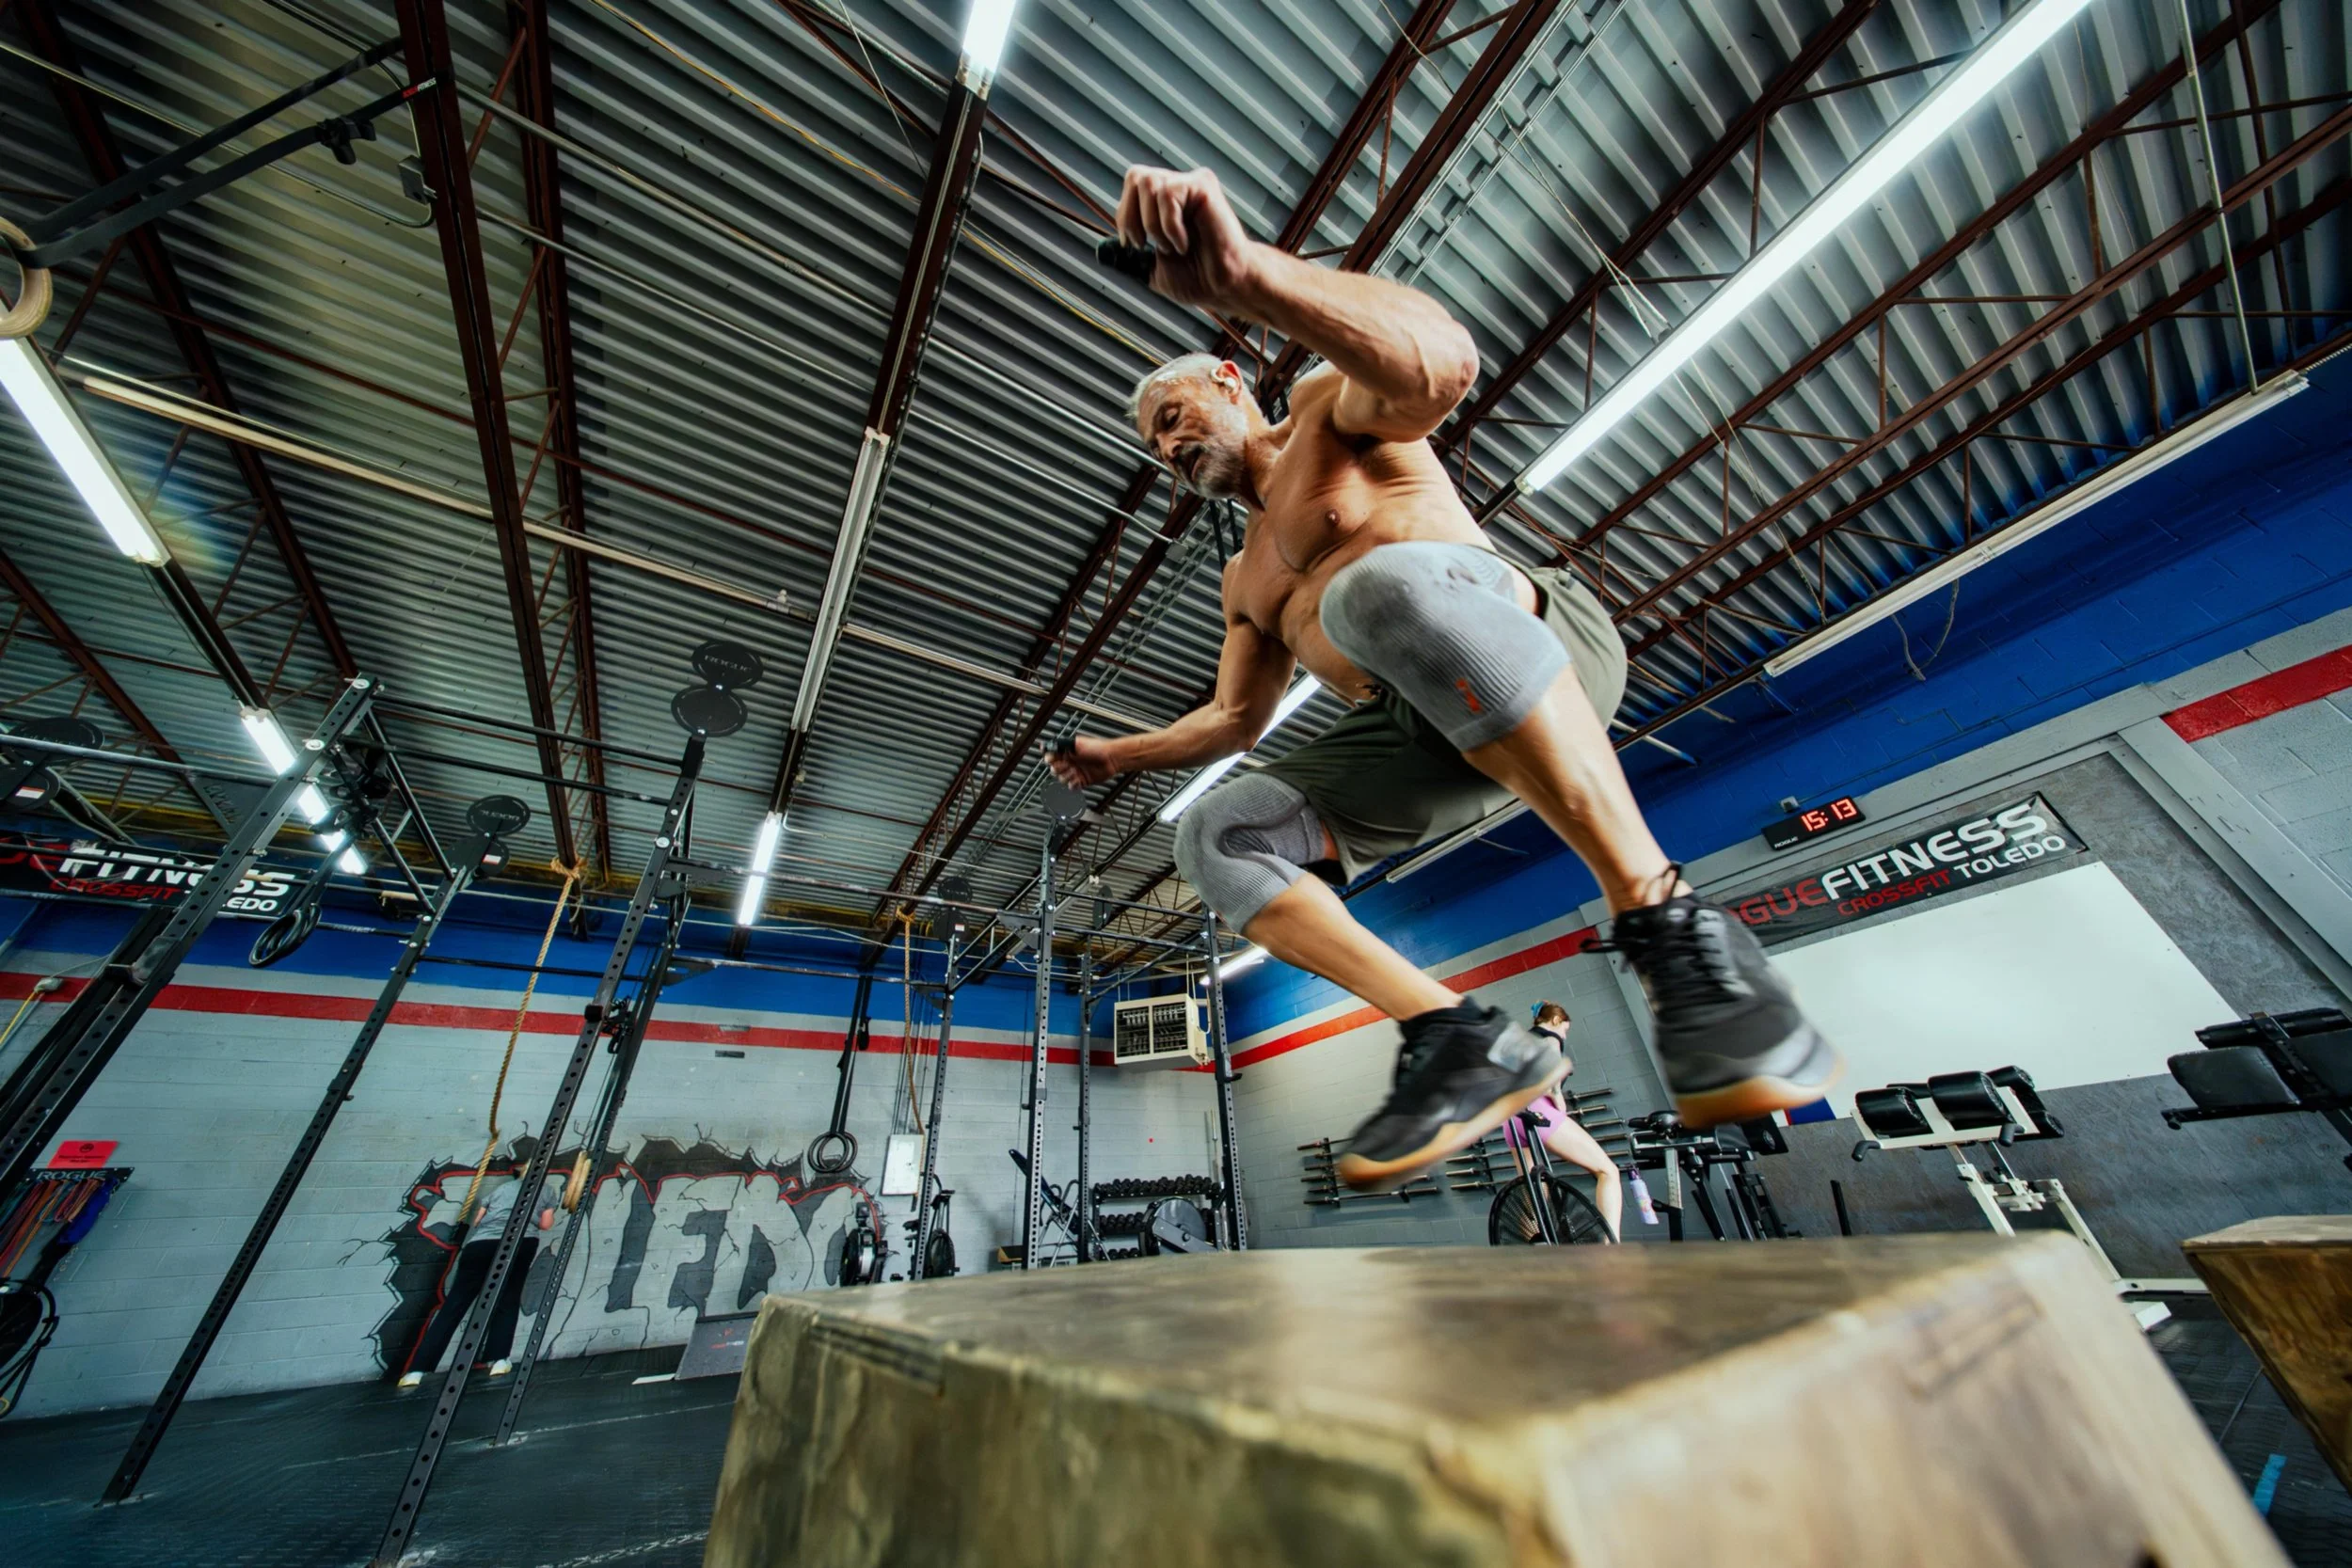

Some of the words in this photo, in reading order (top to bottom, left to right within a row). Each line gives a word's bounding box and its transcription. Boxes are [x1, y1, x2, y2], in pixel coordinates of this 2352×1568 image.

[1801, 799, 1857, 832] 15:13
[1725, 802, 2047, 925] GUEFITNESS
[1836, 869, 1950, 917] CROSSFIT
[1953, 835, 2066, 879] TOLEDO
[50, 876, 181, 901] CROSSFIT
[37, 1170, 106, 1180] ROGUE
